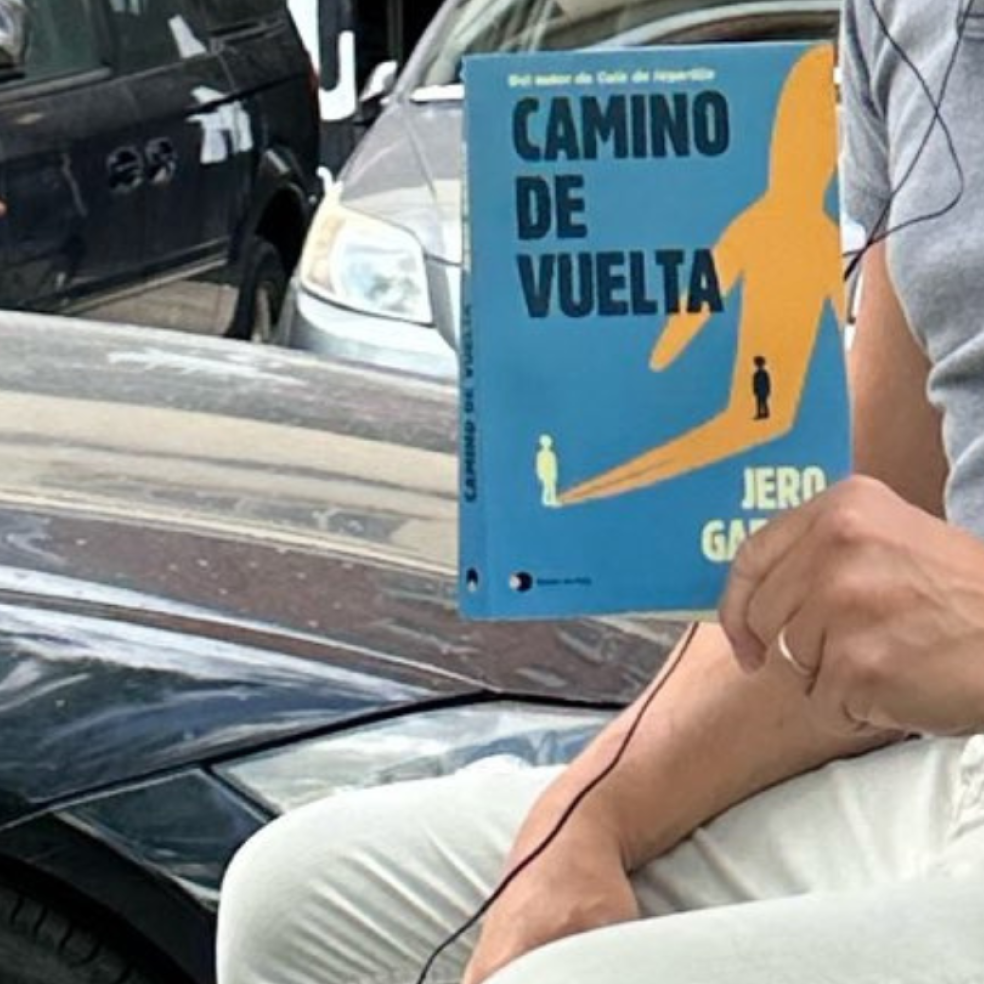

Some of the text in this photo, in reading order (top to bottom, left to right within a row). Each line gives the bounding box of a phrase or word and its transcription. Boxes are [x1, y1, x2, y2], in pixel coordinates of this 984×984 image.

[511, 90, 730, 161] CAMINO
[515, 174, 588, 240] DE
[516, 249, 724, 318] VUELTA
[740, 466, 827, 510] JERO
